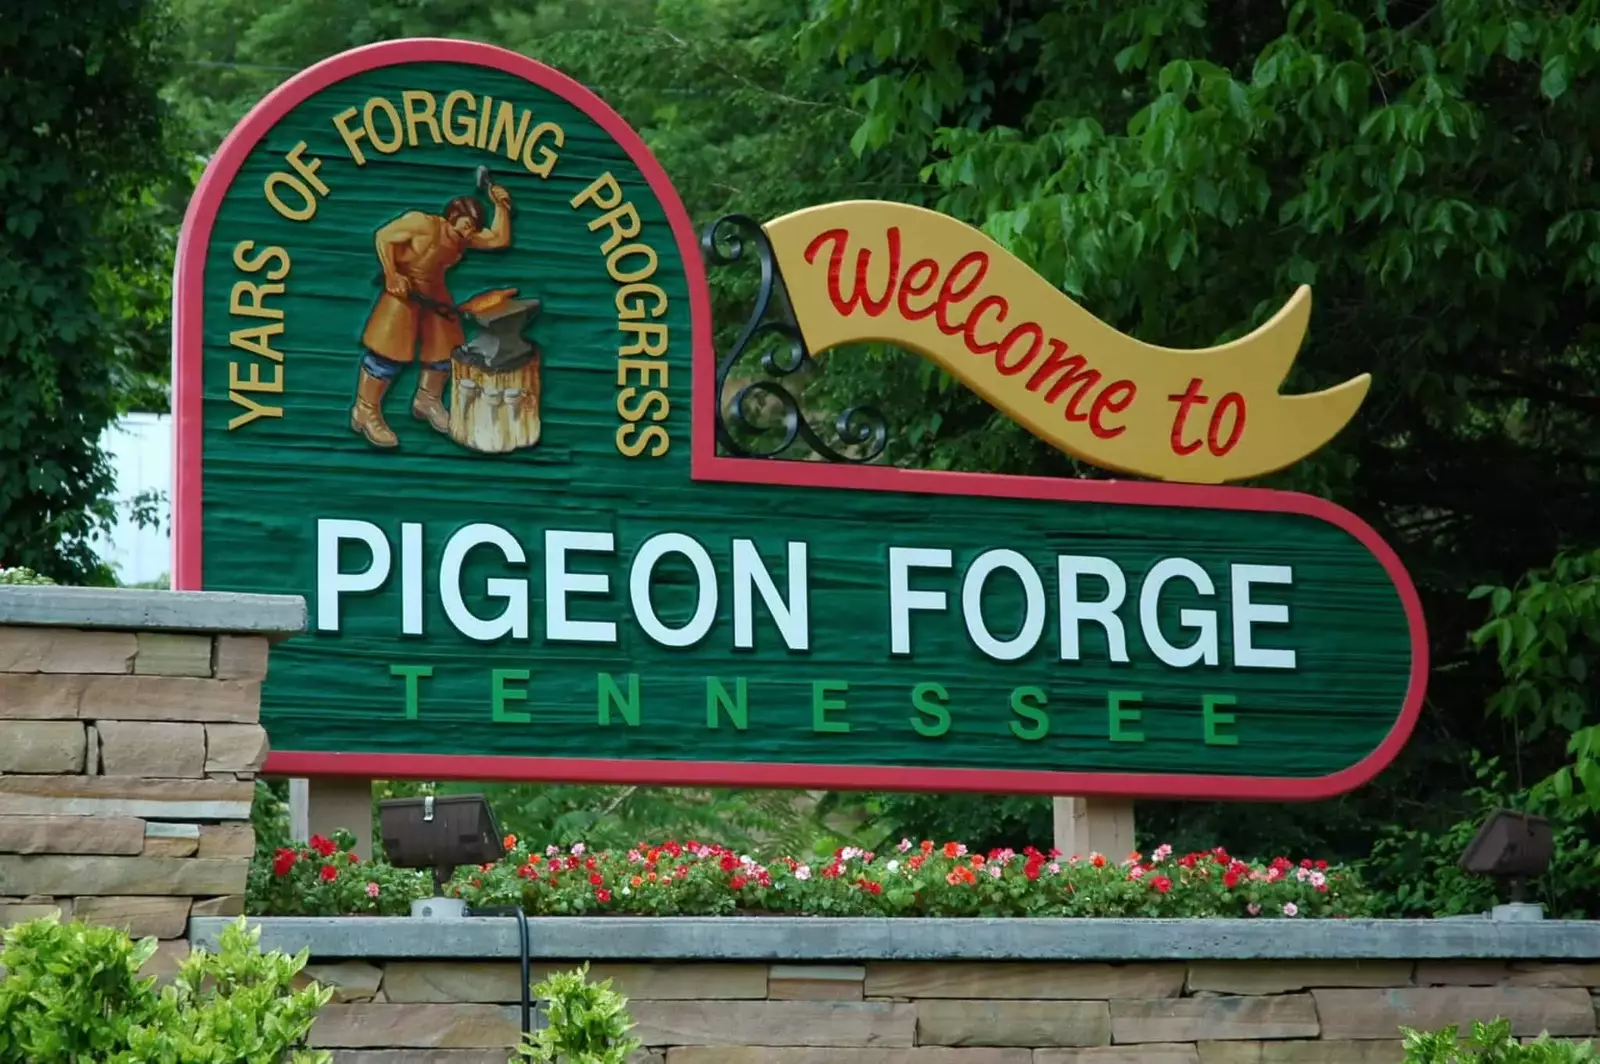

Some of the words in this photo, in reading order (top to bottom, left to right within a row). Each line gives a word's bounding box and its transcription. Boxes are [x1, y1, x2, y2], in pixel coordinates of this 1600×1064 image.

[228, 240, 291, 431] YEARS
[263, 141, 331, 221] OF
[333, 90, 565, 178] FORGING
[570, 171, 670, 457] PROGRESS
[804, 227, 1136, 438] Welcome
[1168, 378, 1247, 457] to
[316, 518, 809, 651] PIGEON
[889, 547, 1297, 670] FORGE
[390, 665, 1239, 746] TENNESSEE
